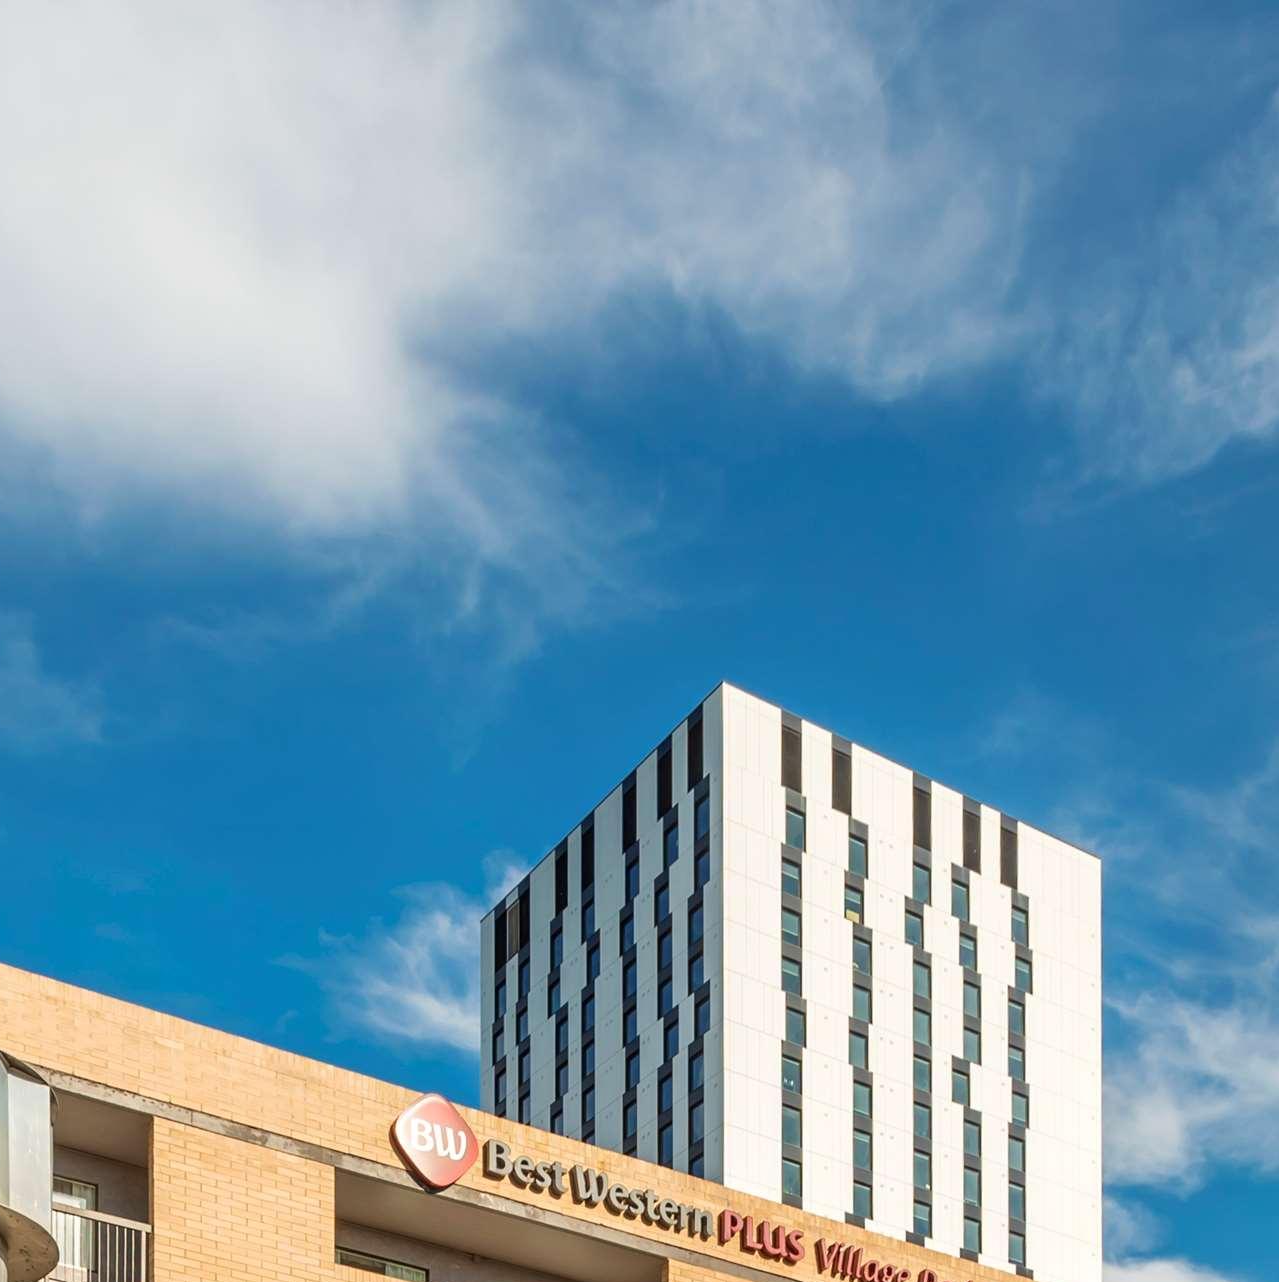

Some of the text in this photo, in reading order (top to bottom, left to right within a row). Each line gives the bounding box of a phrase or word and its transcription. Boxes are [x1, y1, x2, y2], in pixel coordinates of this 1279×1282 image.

[410, 1118, 467, 1161] BW
[483, 1138, 568, 1198] Best
[570, 1164, 715, 1242] Western
[718, 1208, 806, 1265] PLUS
